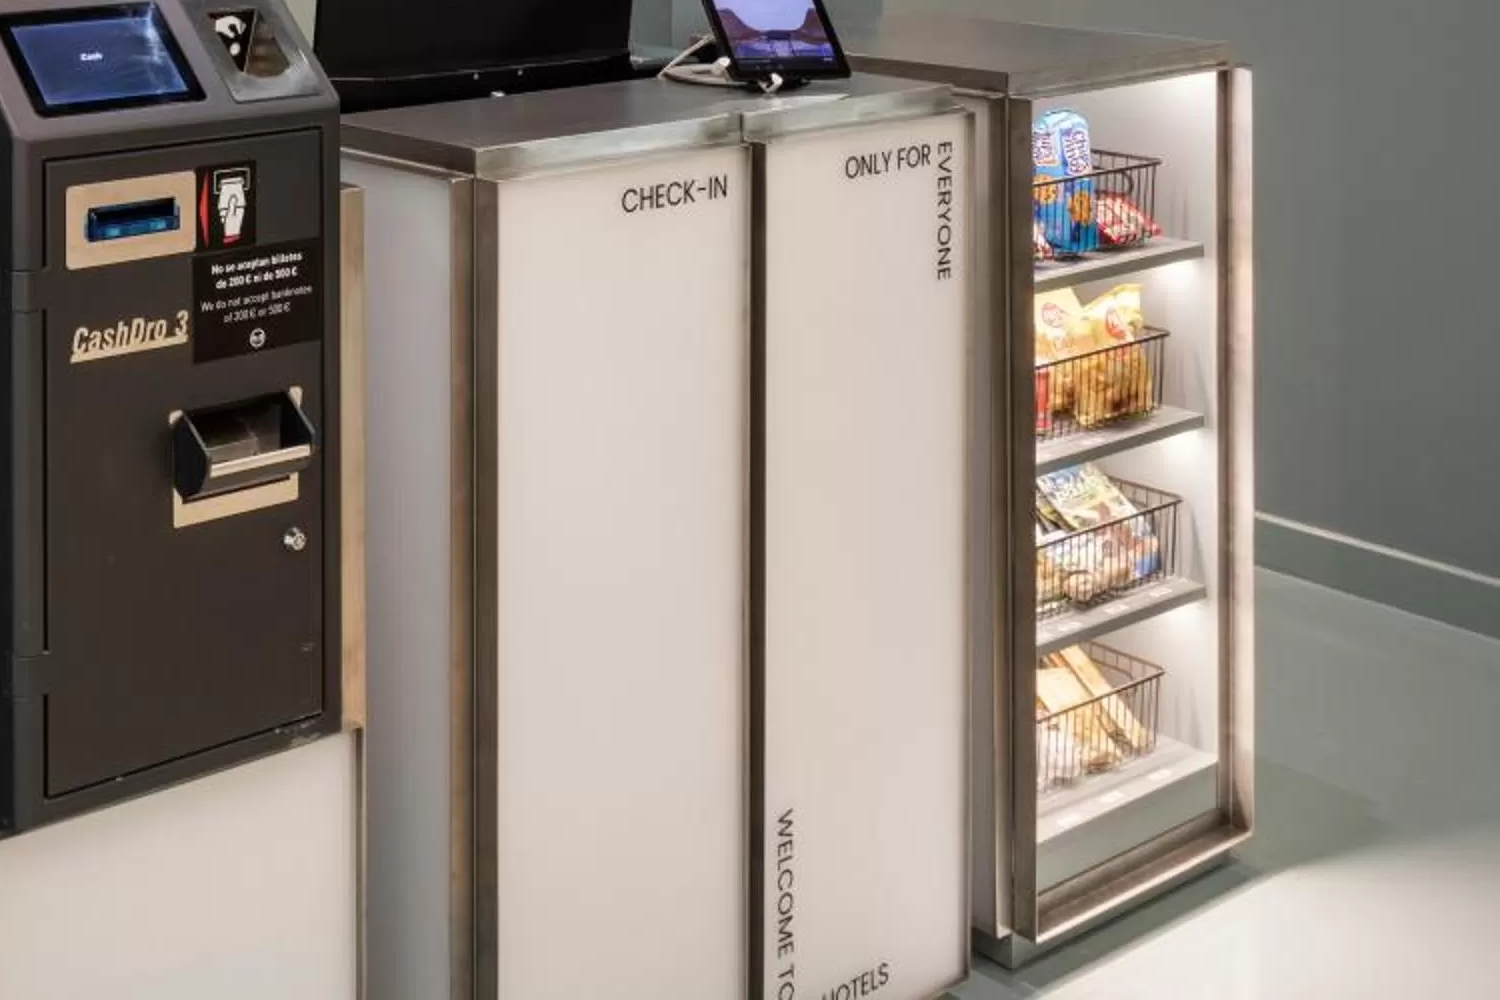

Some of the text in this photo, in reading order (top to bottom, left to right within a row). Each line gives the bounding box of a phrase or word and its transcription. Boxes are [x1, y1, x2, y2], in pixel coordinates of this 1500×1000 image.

[845, 144, 931, 179] ONLY FOR
[622, 175, 728, 213] CHECK-IN
[937, 141, 953, 280] EVERYONE
[72, 309, 189, 356] CashDro 3
[777, 808, 795, 959] WELCOME
